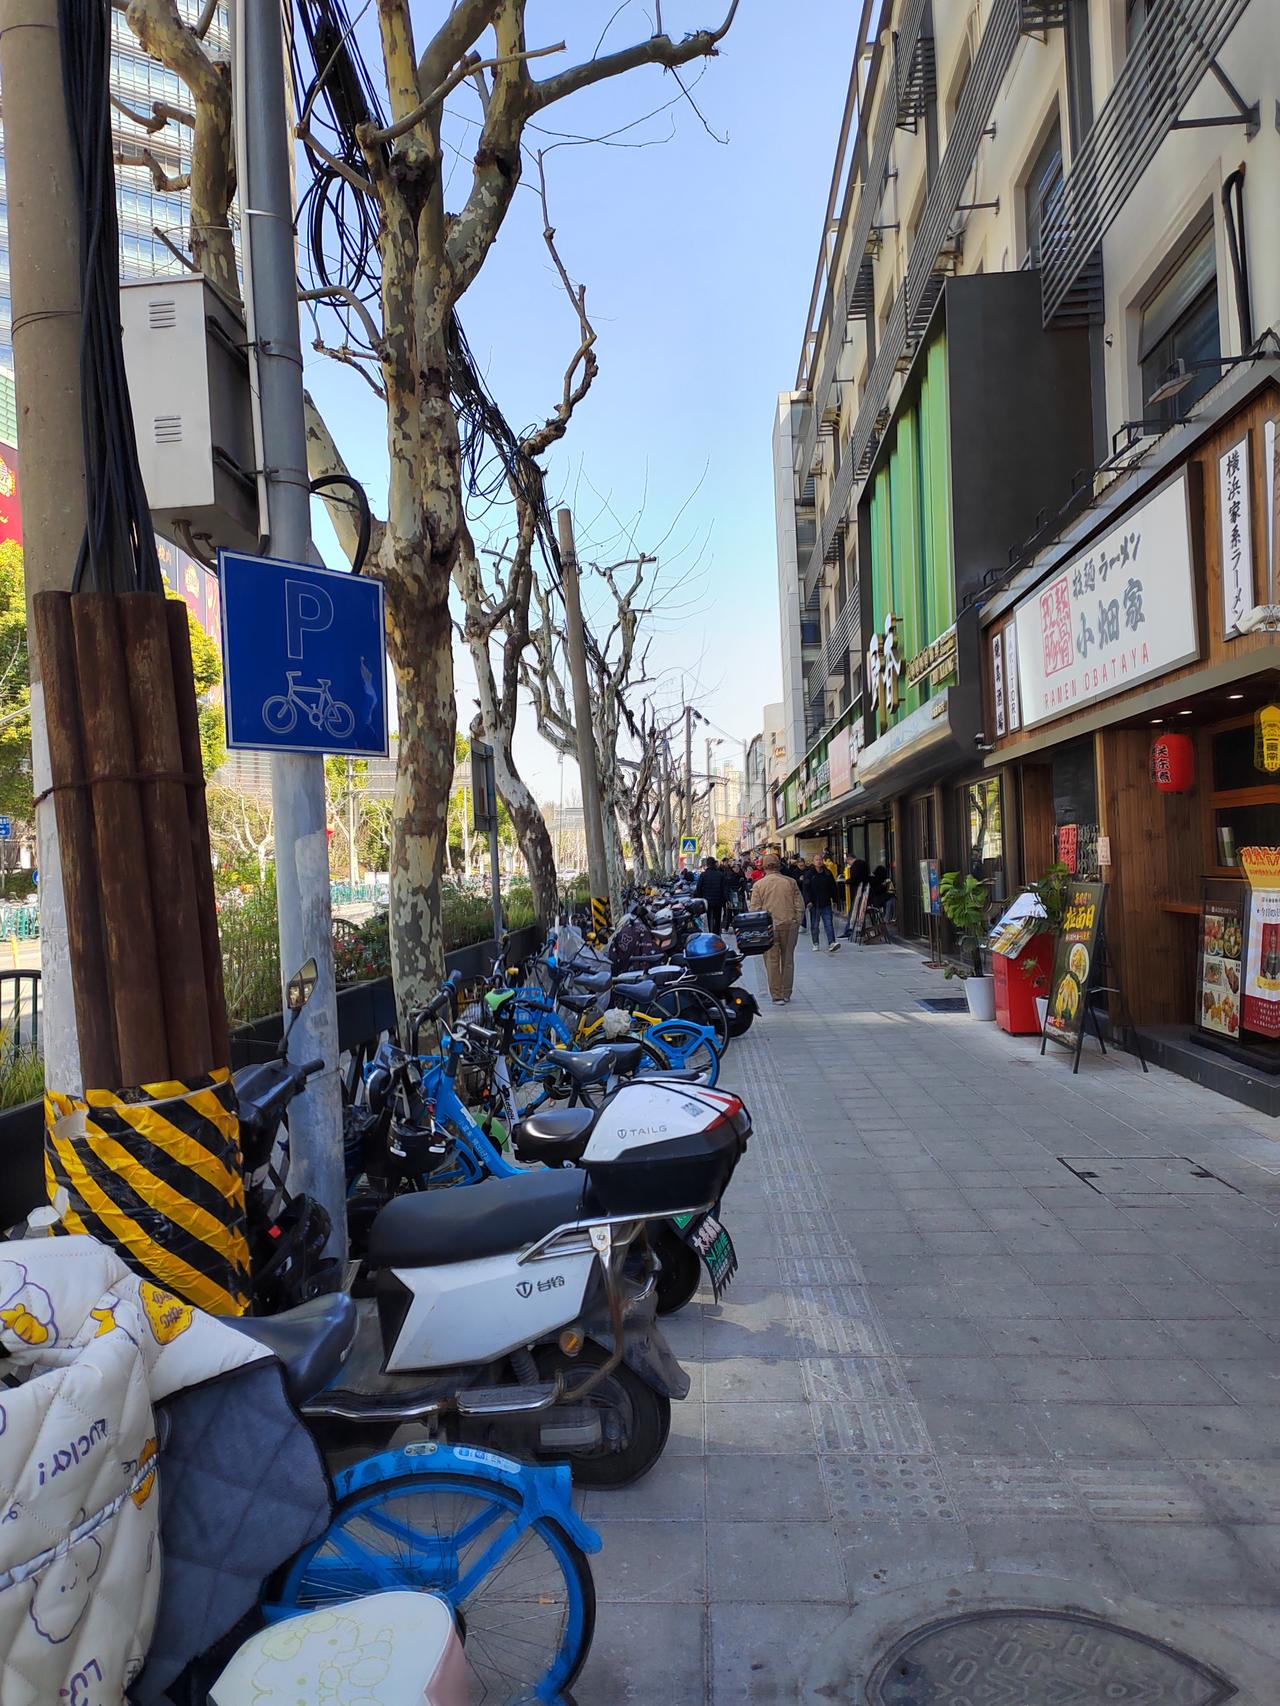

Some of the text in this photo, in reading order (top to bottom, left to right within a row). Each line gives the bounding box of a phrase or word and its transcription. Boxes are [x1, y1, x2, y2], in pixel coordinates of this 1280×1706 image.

[284, 578, 335, 660] P
[1077, 577, 1146, 659] 小畑家
[1044, 642, 1149, 709] RAMEN OBATAYA
[629, 1125, 668, 1137] TAILG
[537, 1275, 565, 1292] 台铃
